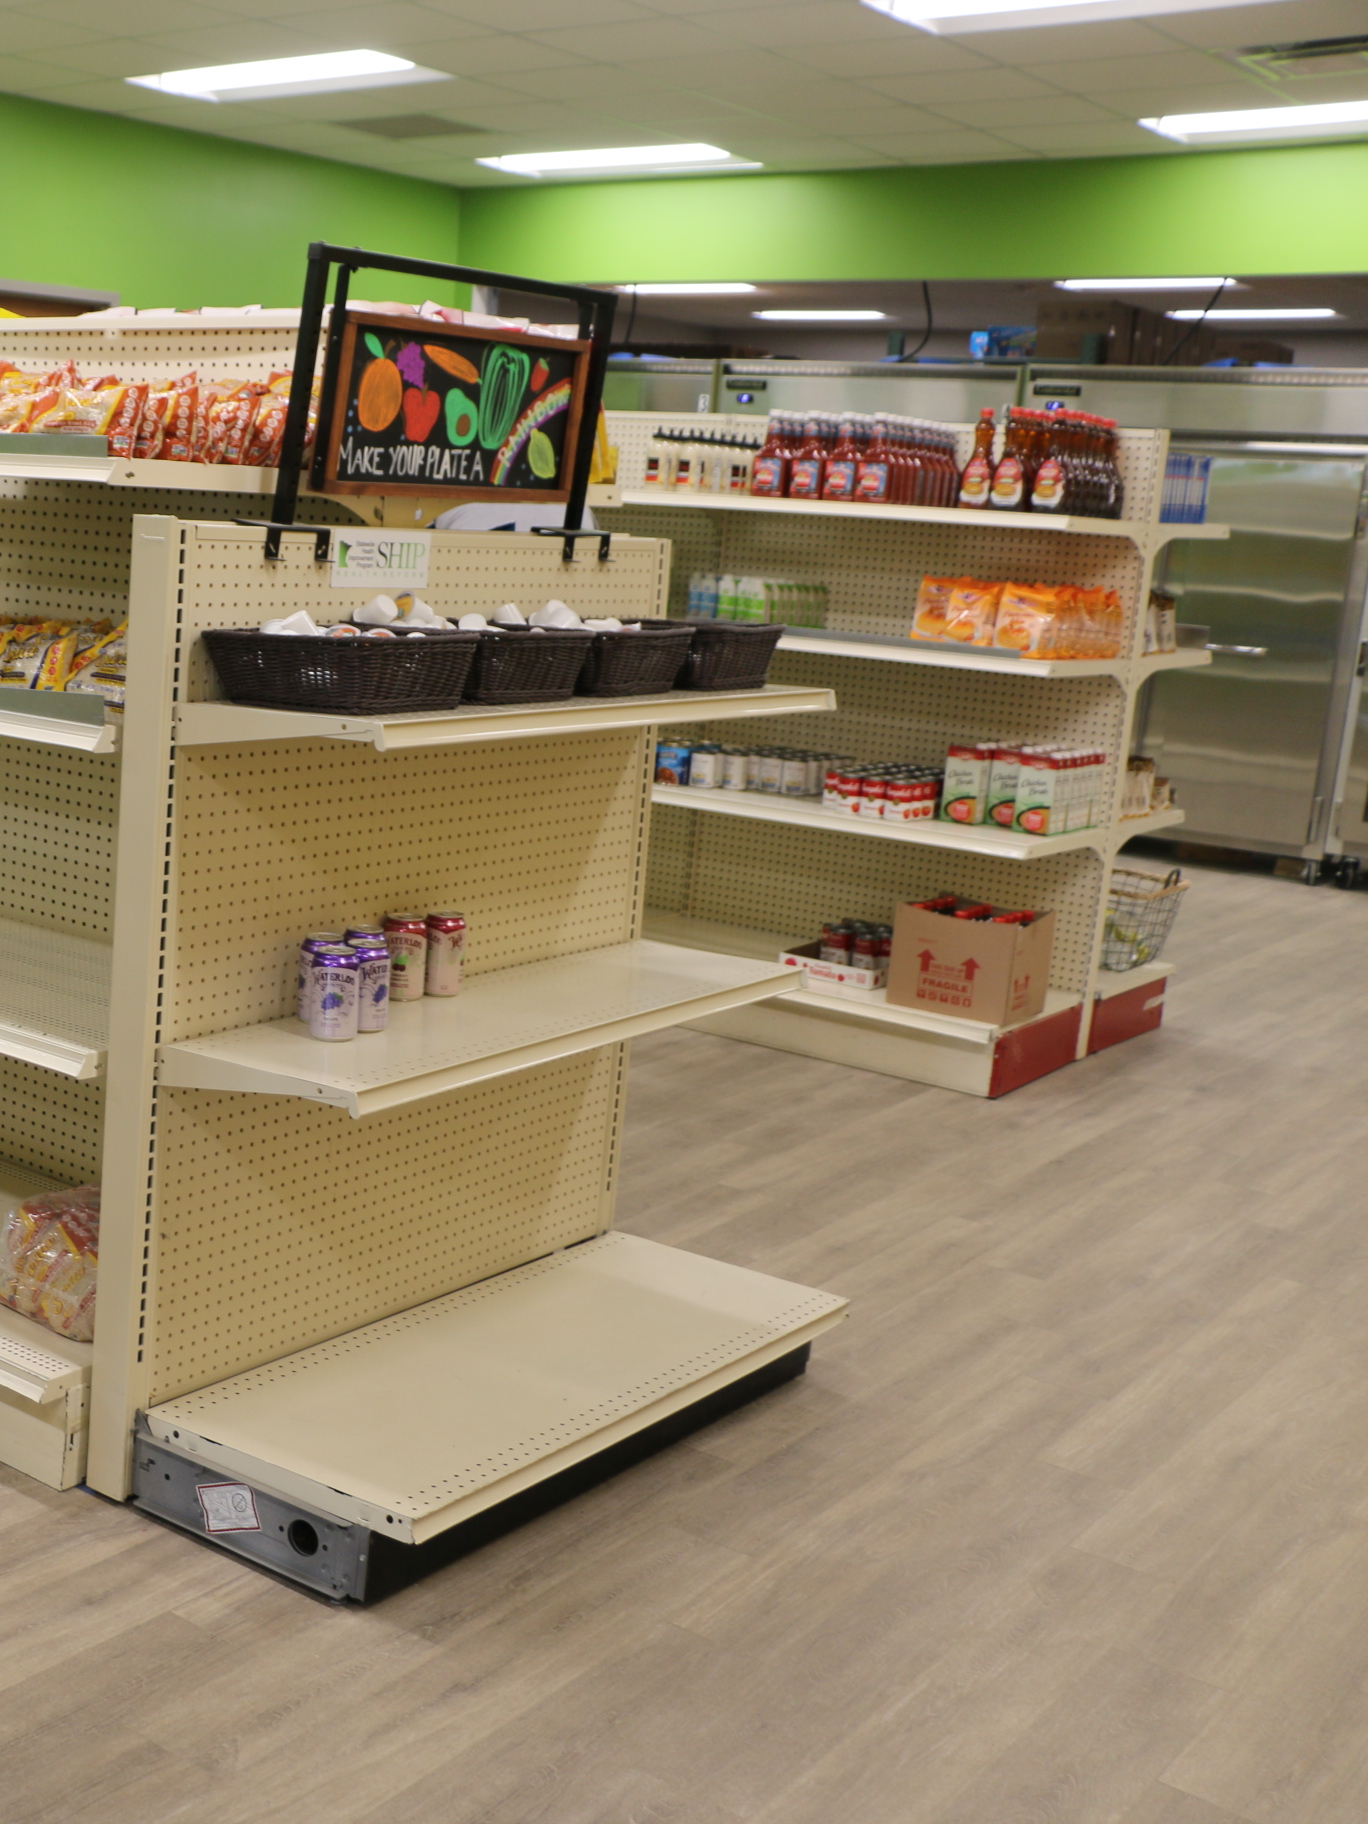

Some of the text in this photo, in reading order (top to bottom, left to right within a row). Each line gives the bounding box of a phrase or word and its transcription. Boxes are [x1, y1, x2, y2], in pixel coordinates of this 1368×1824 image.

[498, 383, 571, 467] RAINBOW
[337, 436, 484, 481] MAKE YOUR PLATE A
[376, 541, 426, 569] SHIP
[312, 968, 355, 985] WATERLOO
[922, 977, 969, 993] FRAGILE
